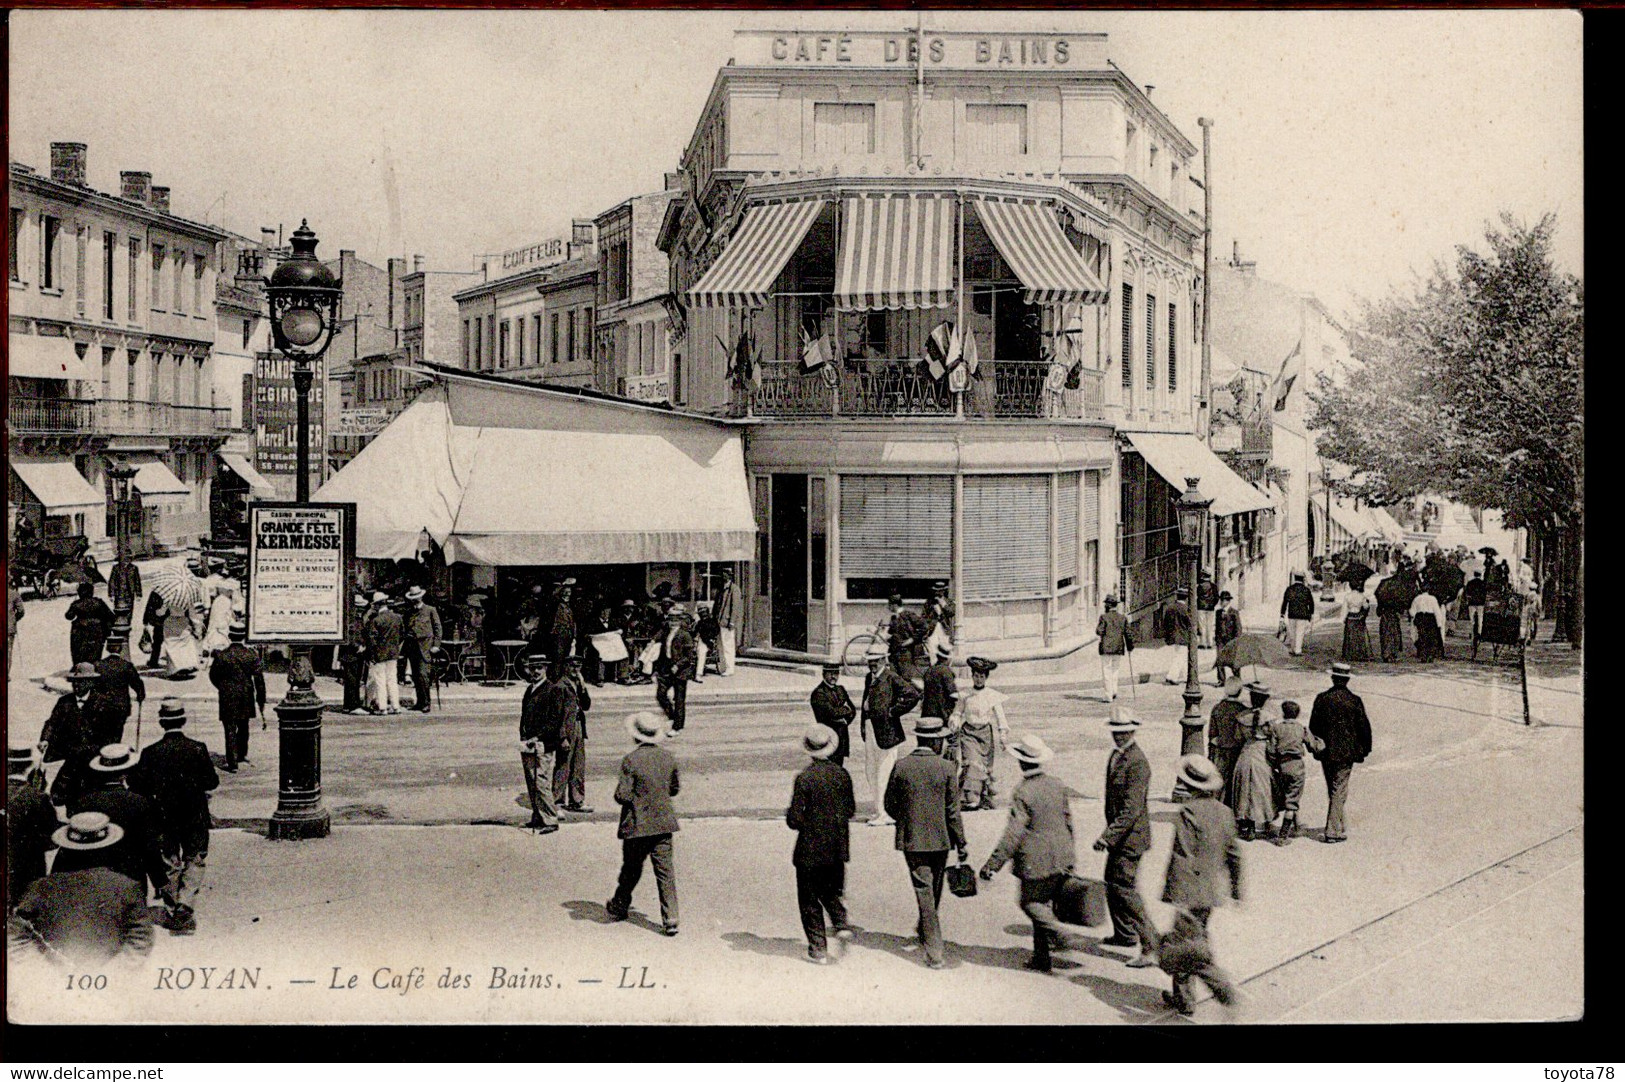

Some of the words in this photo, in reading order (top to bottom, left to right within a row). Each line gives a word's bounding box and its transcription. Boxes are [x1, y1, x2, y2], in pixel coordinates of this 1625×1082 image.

[771, 33, 852, 61] CAFÉ
[884, 38, 945, 63] DES
[975, 38, 1070, 64] BAINS
[503, 239, 561, 269] COIFFEUR
[267, 387, 322, 402] GIRODE
[295, 511, 327, 519] MUNICIPAL
[261, 522, 305, 534] GRANDE
[256, 534, 341, 550] KERMESSE
[260, 565, 291, 573] GRANDE
[295, 565, 336, 573] KERMESSE
